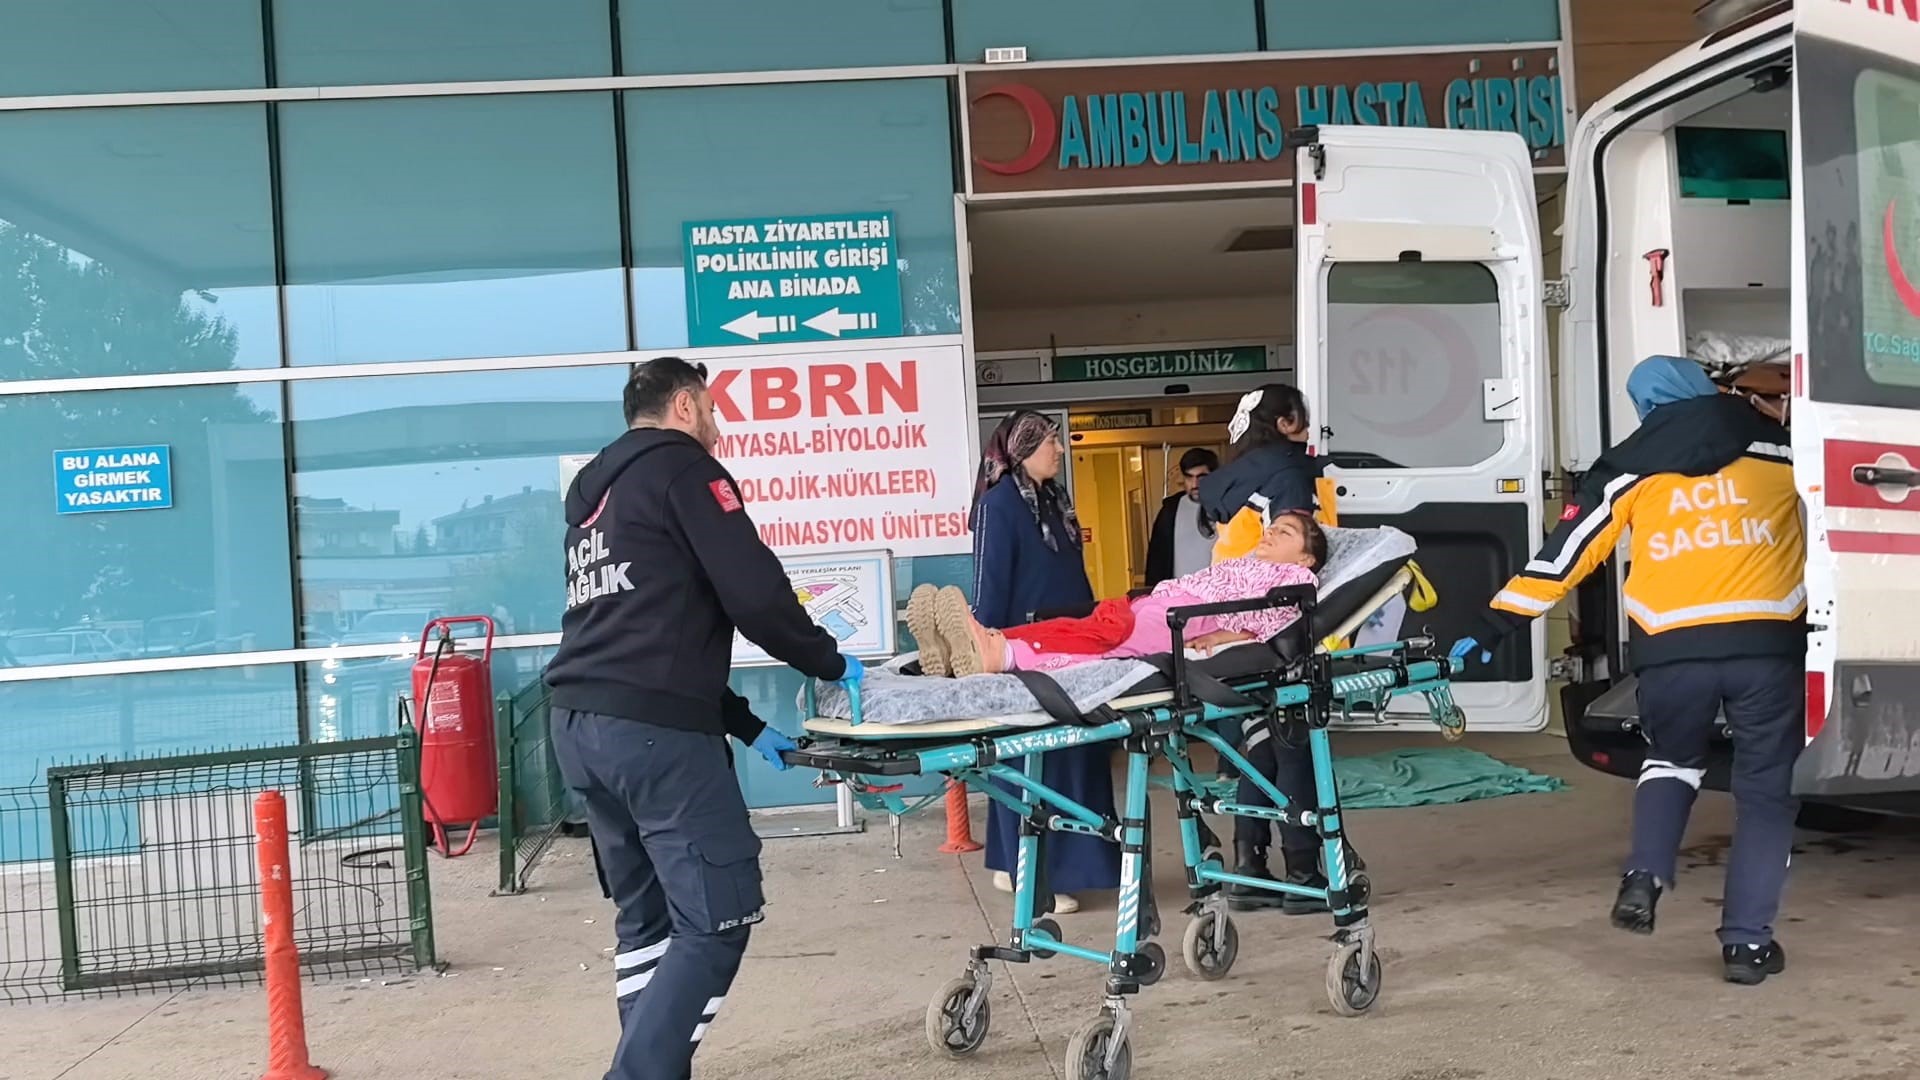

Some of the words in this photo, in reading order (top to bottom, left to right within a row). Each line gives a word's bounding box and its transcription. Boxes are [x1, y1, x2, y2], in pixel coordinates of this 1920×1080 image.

[1058, 86, 1282, 168] AMBULANS
[1296, 81, 1429, 127] HASTA
[1444, 56, 1565, 160] GİRİŞİ
[691, 225, 760, 246] HASTA
[763, 216, 890, 244] ZİYARETLERİ
[696, 245, 819, 273] POLİKLİNİK
[824, 241, 889, 271] GİRİŞİ
[728, 279, 775, 300] ANA
[779, 273, 861, 297] BİNADA
[1085, 350, 1235, 378] HOŞGELDİNİZ
[706, 360, 919, 422] KBRN
[62, 456, 90, 471] BU
[95, 451, 161, 469] ALANA
[73, 470, 151, 487] GİRMEK
[64, 487, 163, 506] YASAKTIR
[736, 468, 937, 504] OLOJİK-NÜKLEER)
[1668, 472, 1750, 516] ACİL
[759, 517, 875, 547] MİNASYON
[881, 506, 970, 540] ÜNİTESİ
[1647, 514, 1778, 562] SAĞLIK
[568, 527, 610, 576] ACİL
[566, 561, 636, 610] AĞLIK
